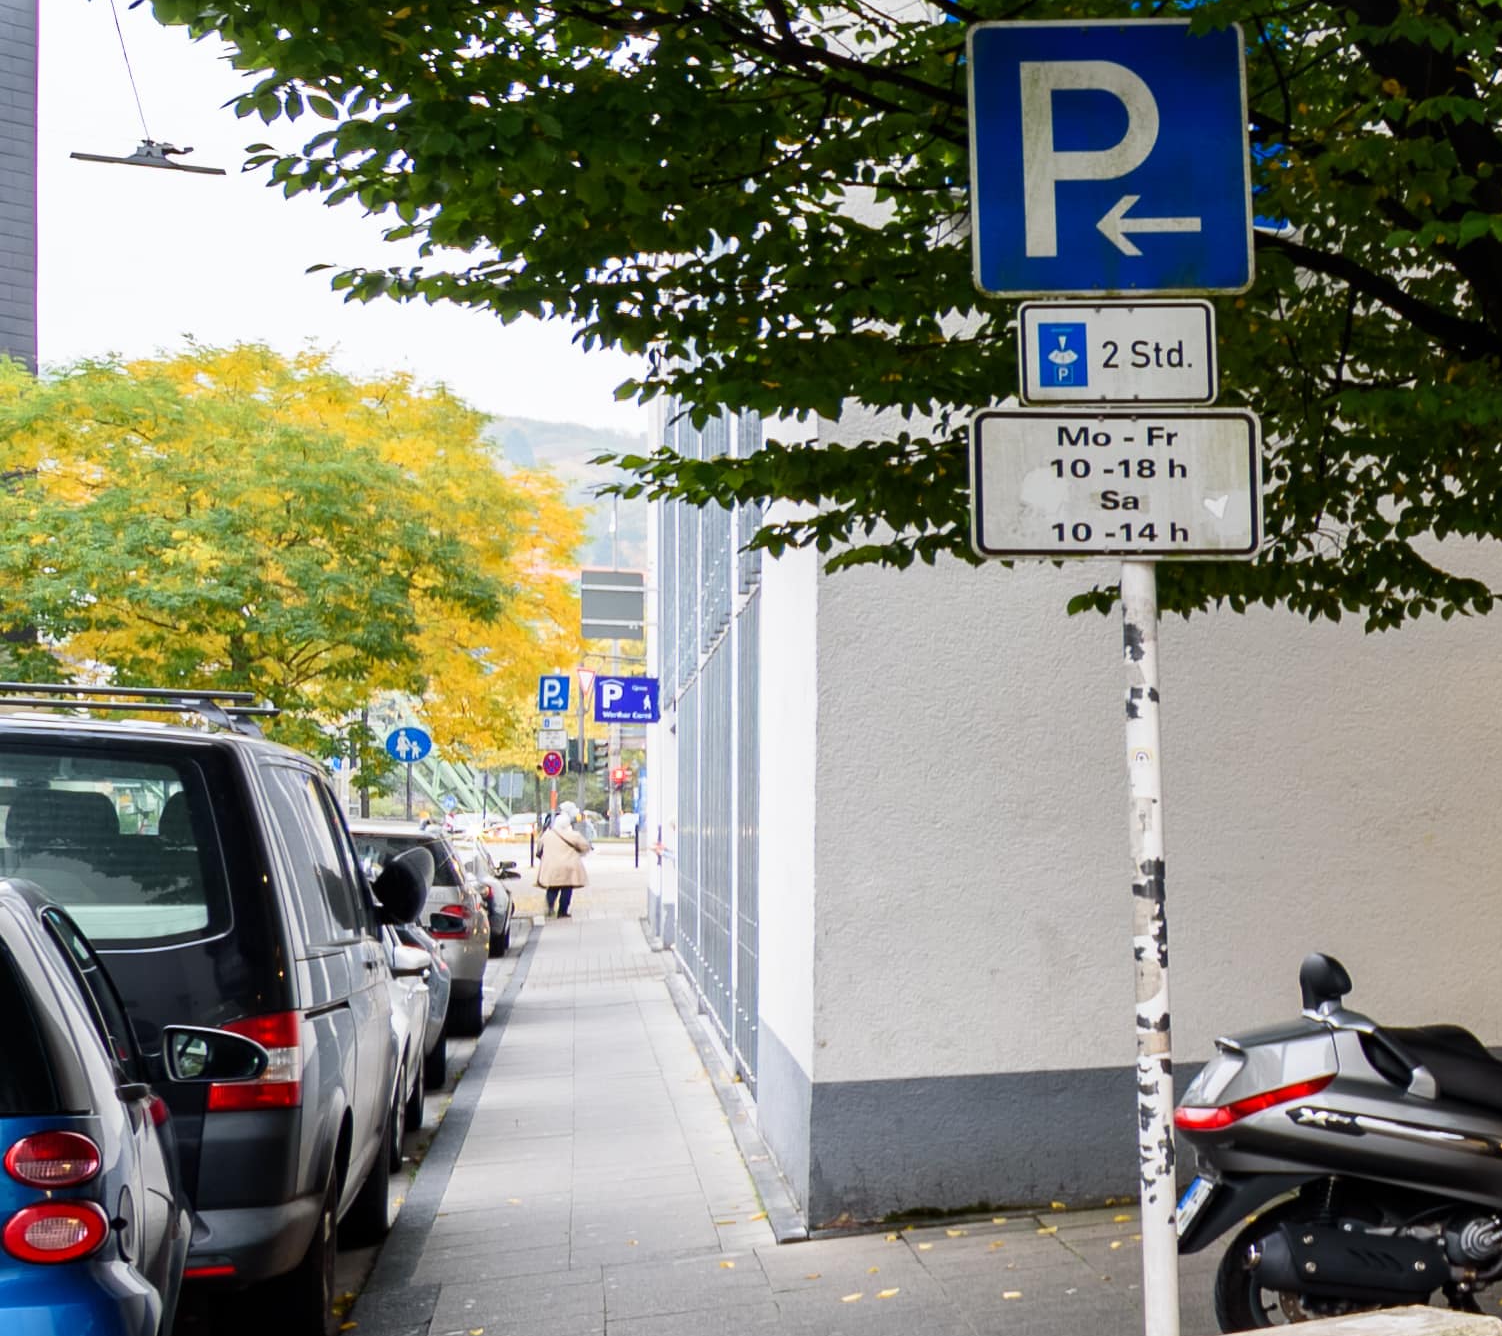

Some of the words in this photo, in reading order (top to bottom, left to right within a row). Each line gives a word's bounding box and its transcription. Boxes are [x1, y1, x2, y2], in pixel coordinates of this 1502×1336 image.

[1020, 60, 1159, 258] P
[1102, 341, 1119, 369] 2
[1131, 340, 1193, 369] Std.
[1057, 425, 1111, 448] Mo
[1147, 426, 1178, 448] Fr
[1051, 459, 1090, 479] 10
[1171, 459, 1188, 479] h
[1100, 490, 1140, 511] Sa
[1051, 523, 1092, 543] 10
[1171, 523, 1189, 543] h
[543, 678, 561, 708] P
[602, 684, 623, 709] P
